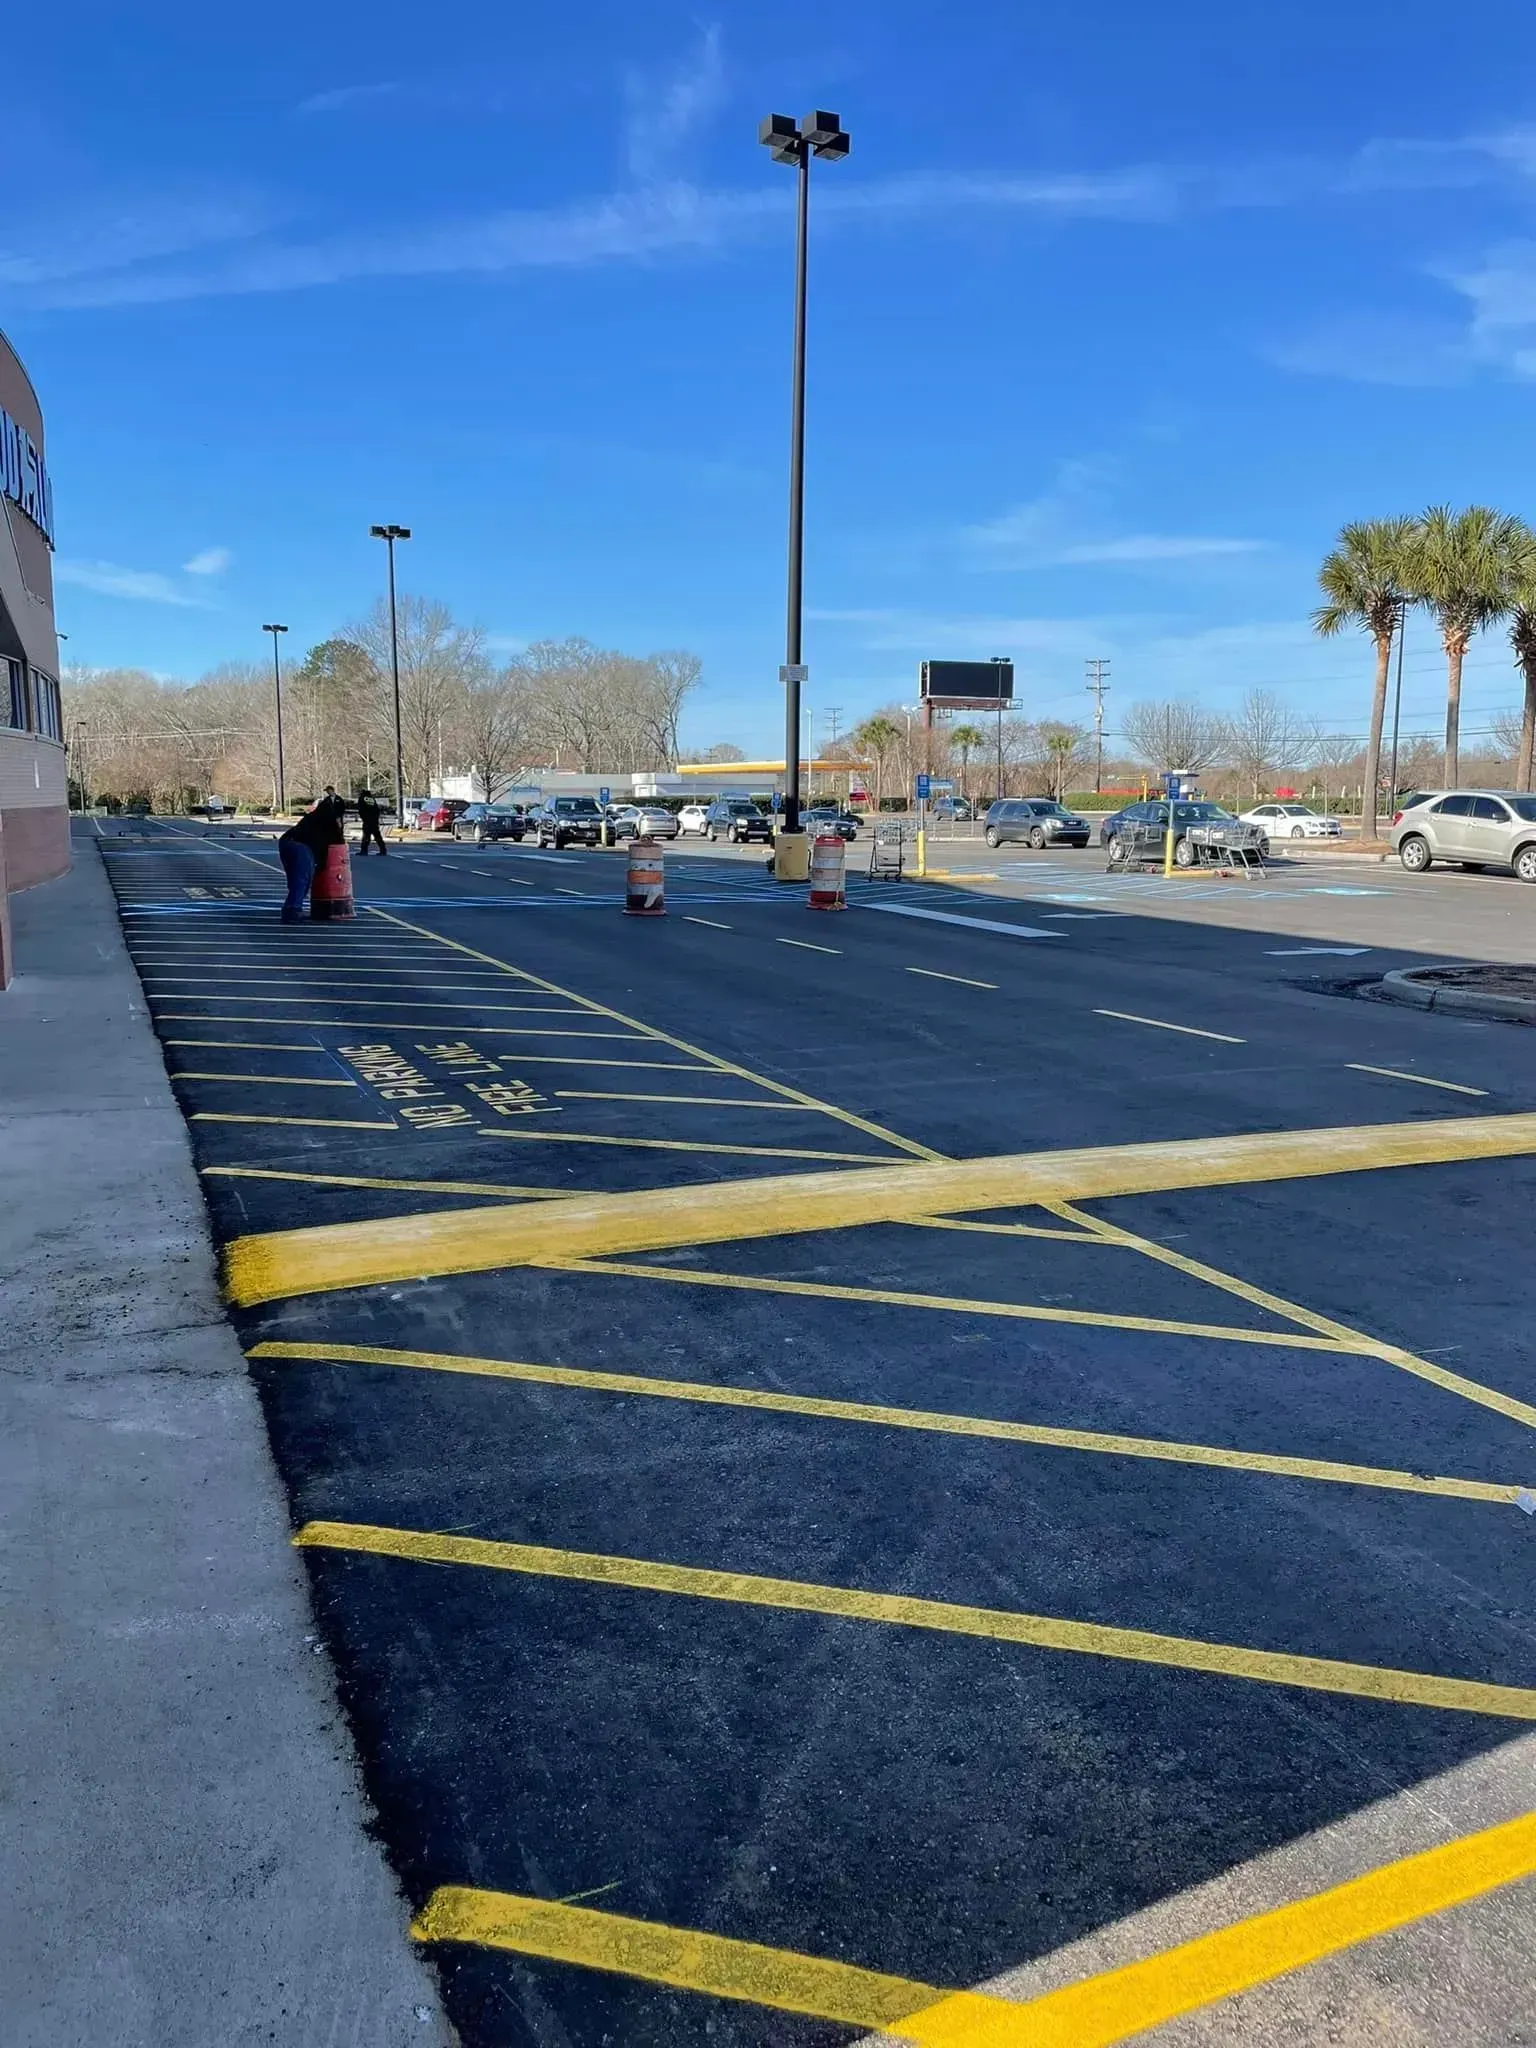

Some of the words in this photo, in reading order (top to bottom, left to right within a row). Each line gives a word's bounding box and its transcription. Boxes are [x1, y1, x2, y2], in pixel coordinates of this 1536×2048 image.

[338, 1044, 446, 1100] PARKING
[414, 1041, 503, 1076] LANE
[464, 1079, 563, 1116] FIRE
[399, 1104, 482, 1130] NO
